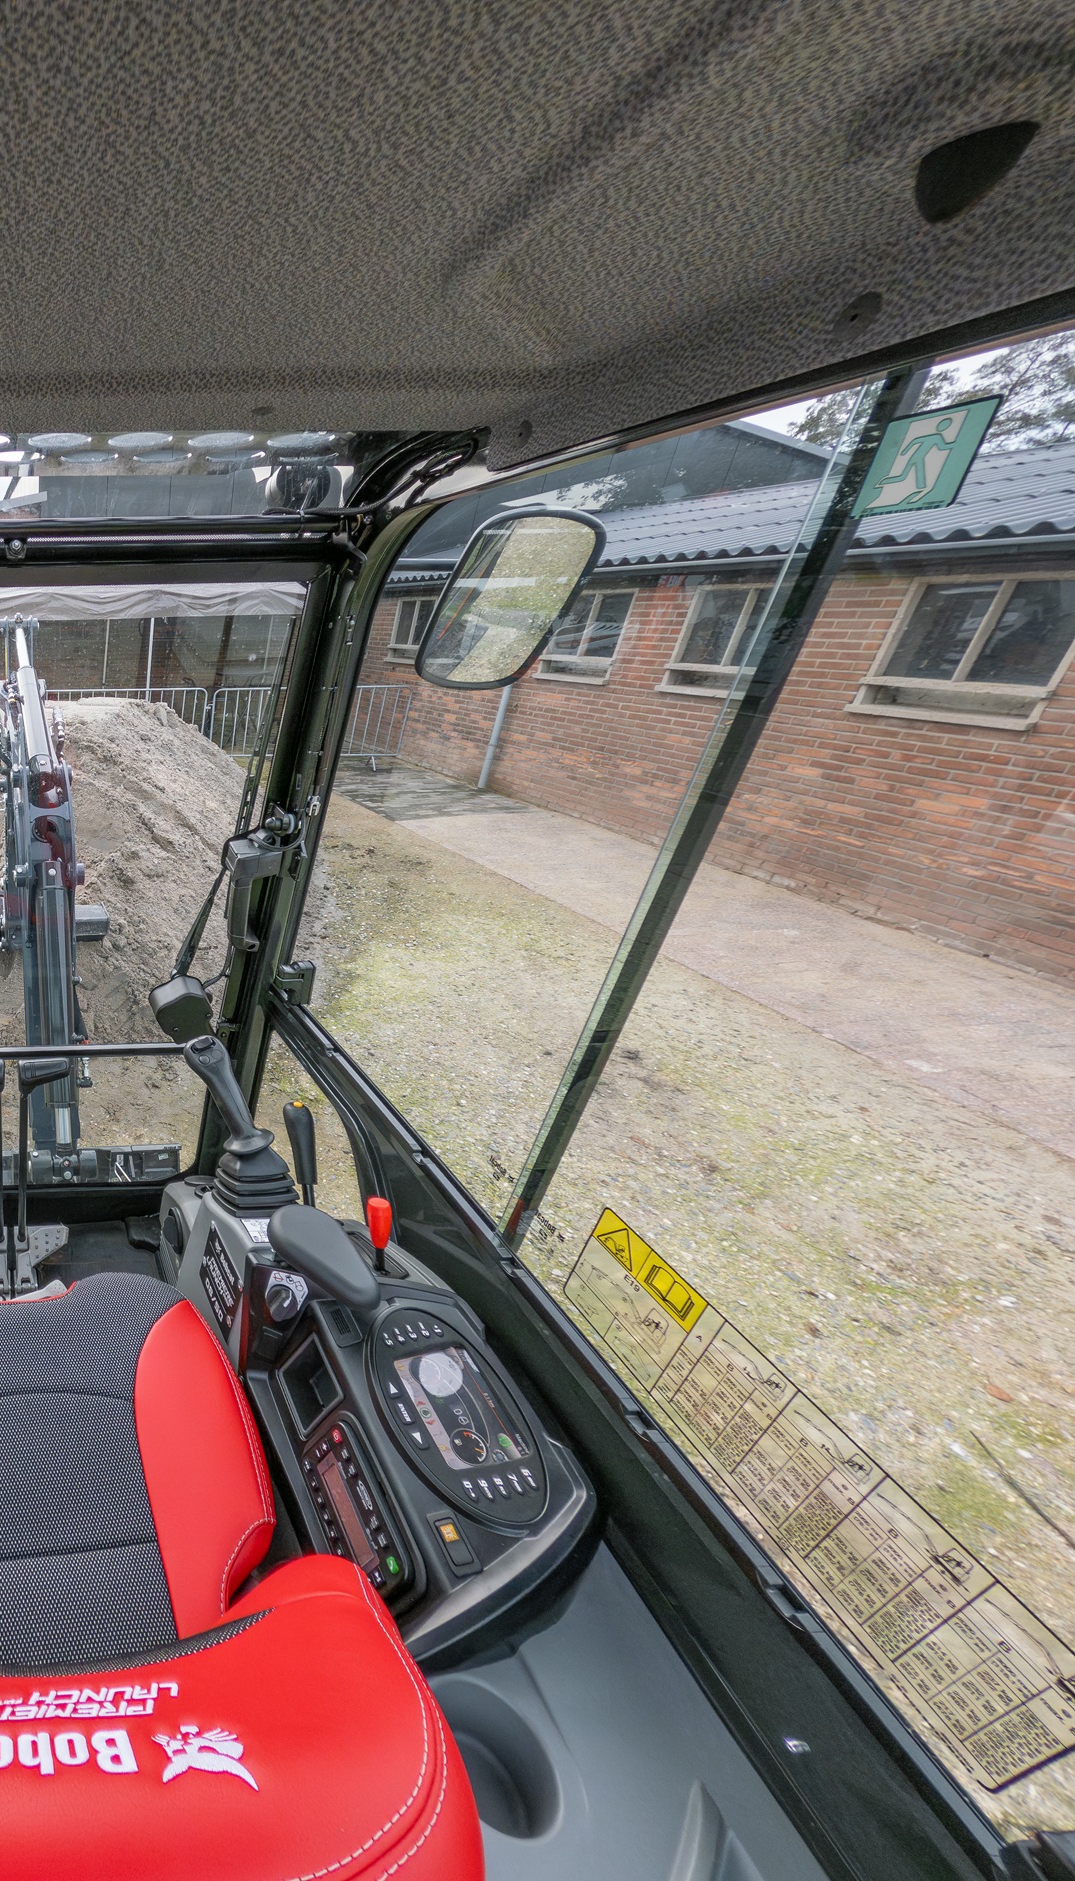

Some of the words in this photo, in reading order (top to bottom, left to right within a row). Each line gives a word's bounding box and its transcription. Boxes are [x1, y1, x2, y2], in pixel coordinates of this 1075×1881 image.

[623, 1273, 641, 1292] E19
[725, 1362, 735, 1372] B
[765, 1412, 773, 1421] B
[798, 1437, 809, 1448] B
[846, 1496, 856, 1506] B
[886, 1527, 899, 1540] B
[944, 1598, 957, 1610] B
[996, 1639, 1012, 1655] B
[28, 1682, 179, 1706] LAUNCH
